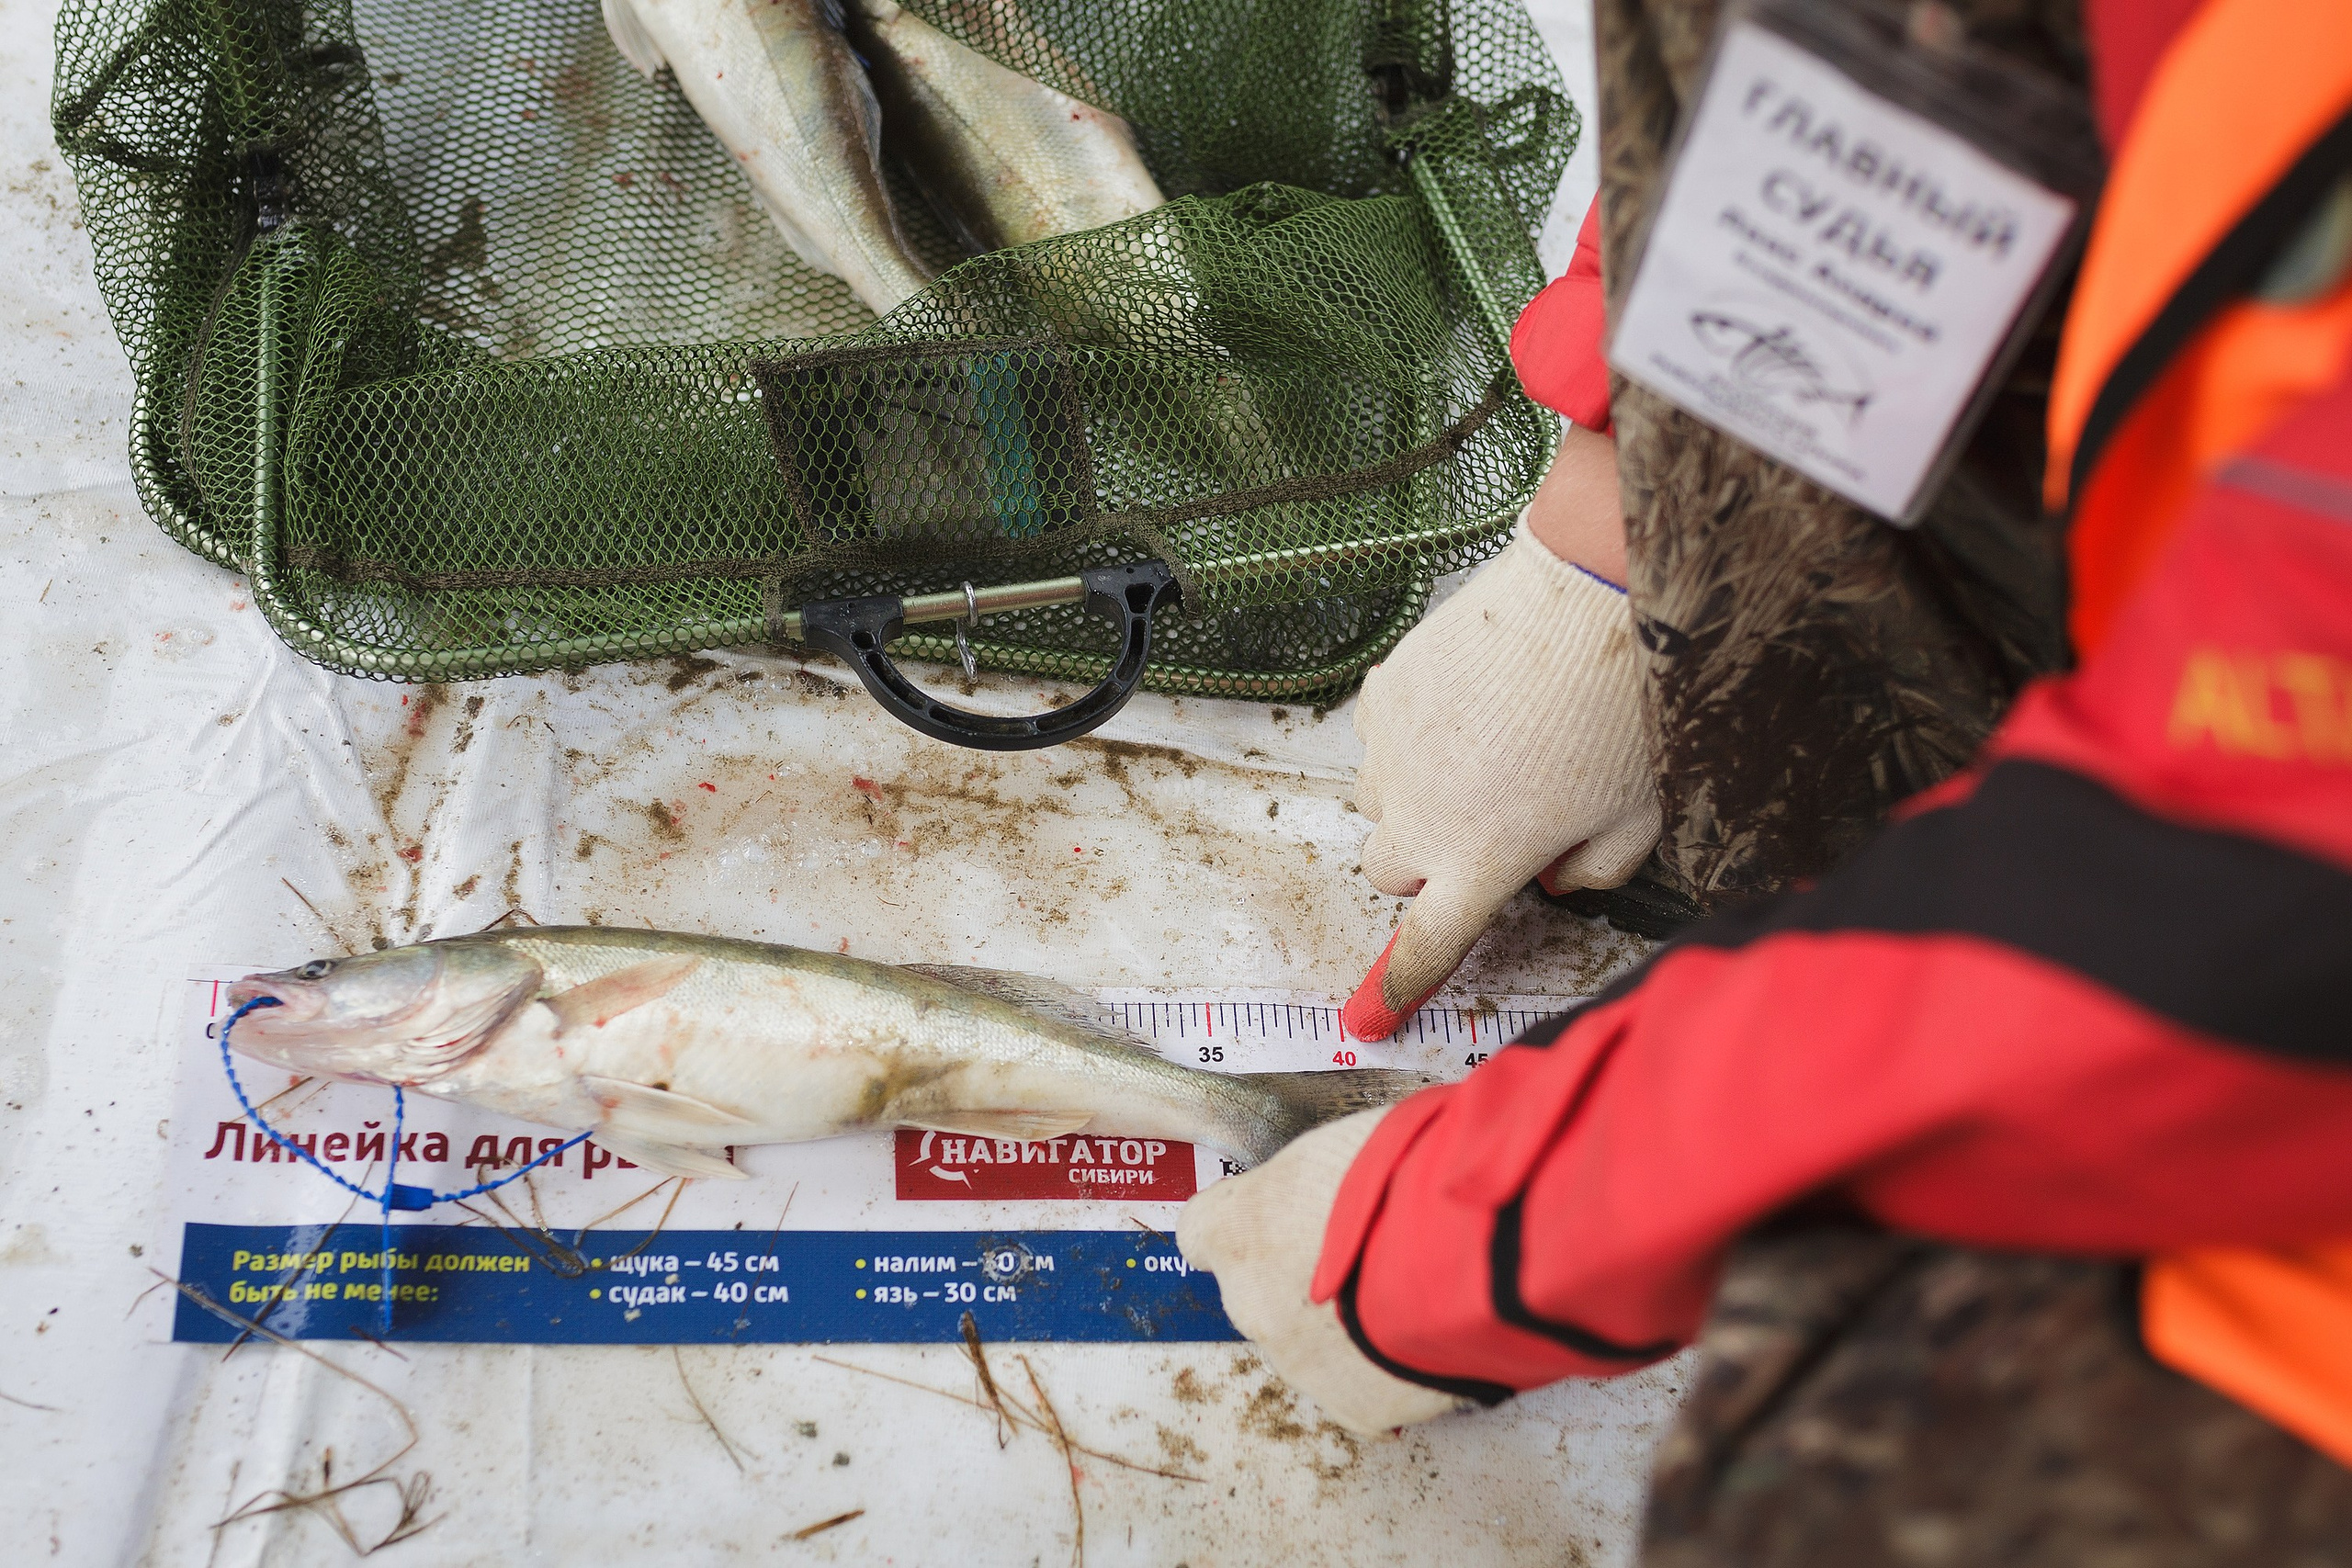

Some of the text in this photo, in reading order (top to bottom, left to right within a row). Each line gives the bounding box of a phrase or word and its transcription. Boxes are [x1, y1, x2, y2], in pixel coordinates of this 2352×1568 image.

[1743, 77, 2018, 261] ГЛАВНЫЙ
[1761, 168, 1940, 288] СУДЬЯ
[2166, 646, 2352, 764] ALT
[1198, 1046, 1225, 1063] 35
[1332, 1051, 1357, 1067] 40
[204, 1121, 450, 1163] Линейка
[465, 1134, 565, 1170] для
[941, 1138, 1167, 1165] НАВИГАТОР
[1068, 1168, 1154, 1184] СИБИРИ
[232, 1247, 531, 1274] Размер рыбы должен
[609, 1255, 679, 1278] щука
[707, 1251, 740, 1272] 45
[744, 1255, 780, 1272] см
[874, 1256, 956, 1272] налим
[229, 1280, 439, 1303] быть не менее:
[608, 1285, 686, 1308] судак
[713, 1281, 748, 1303] 40
[753, 1286, 789, 1303] см
[874, 1286, 919, 1303] язь
[944, 1282, 977, 1303] 30
[983, 1286, 1017, 1303] см
